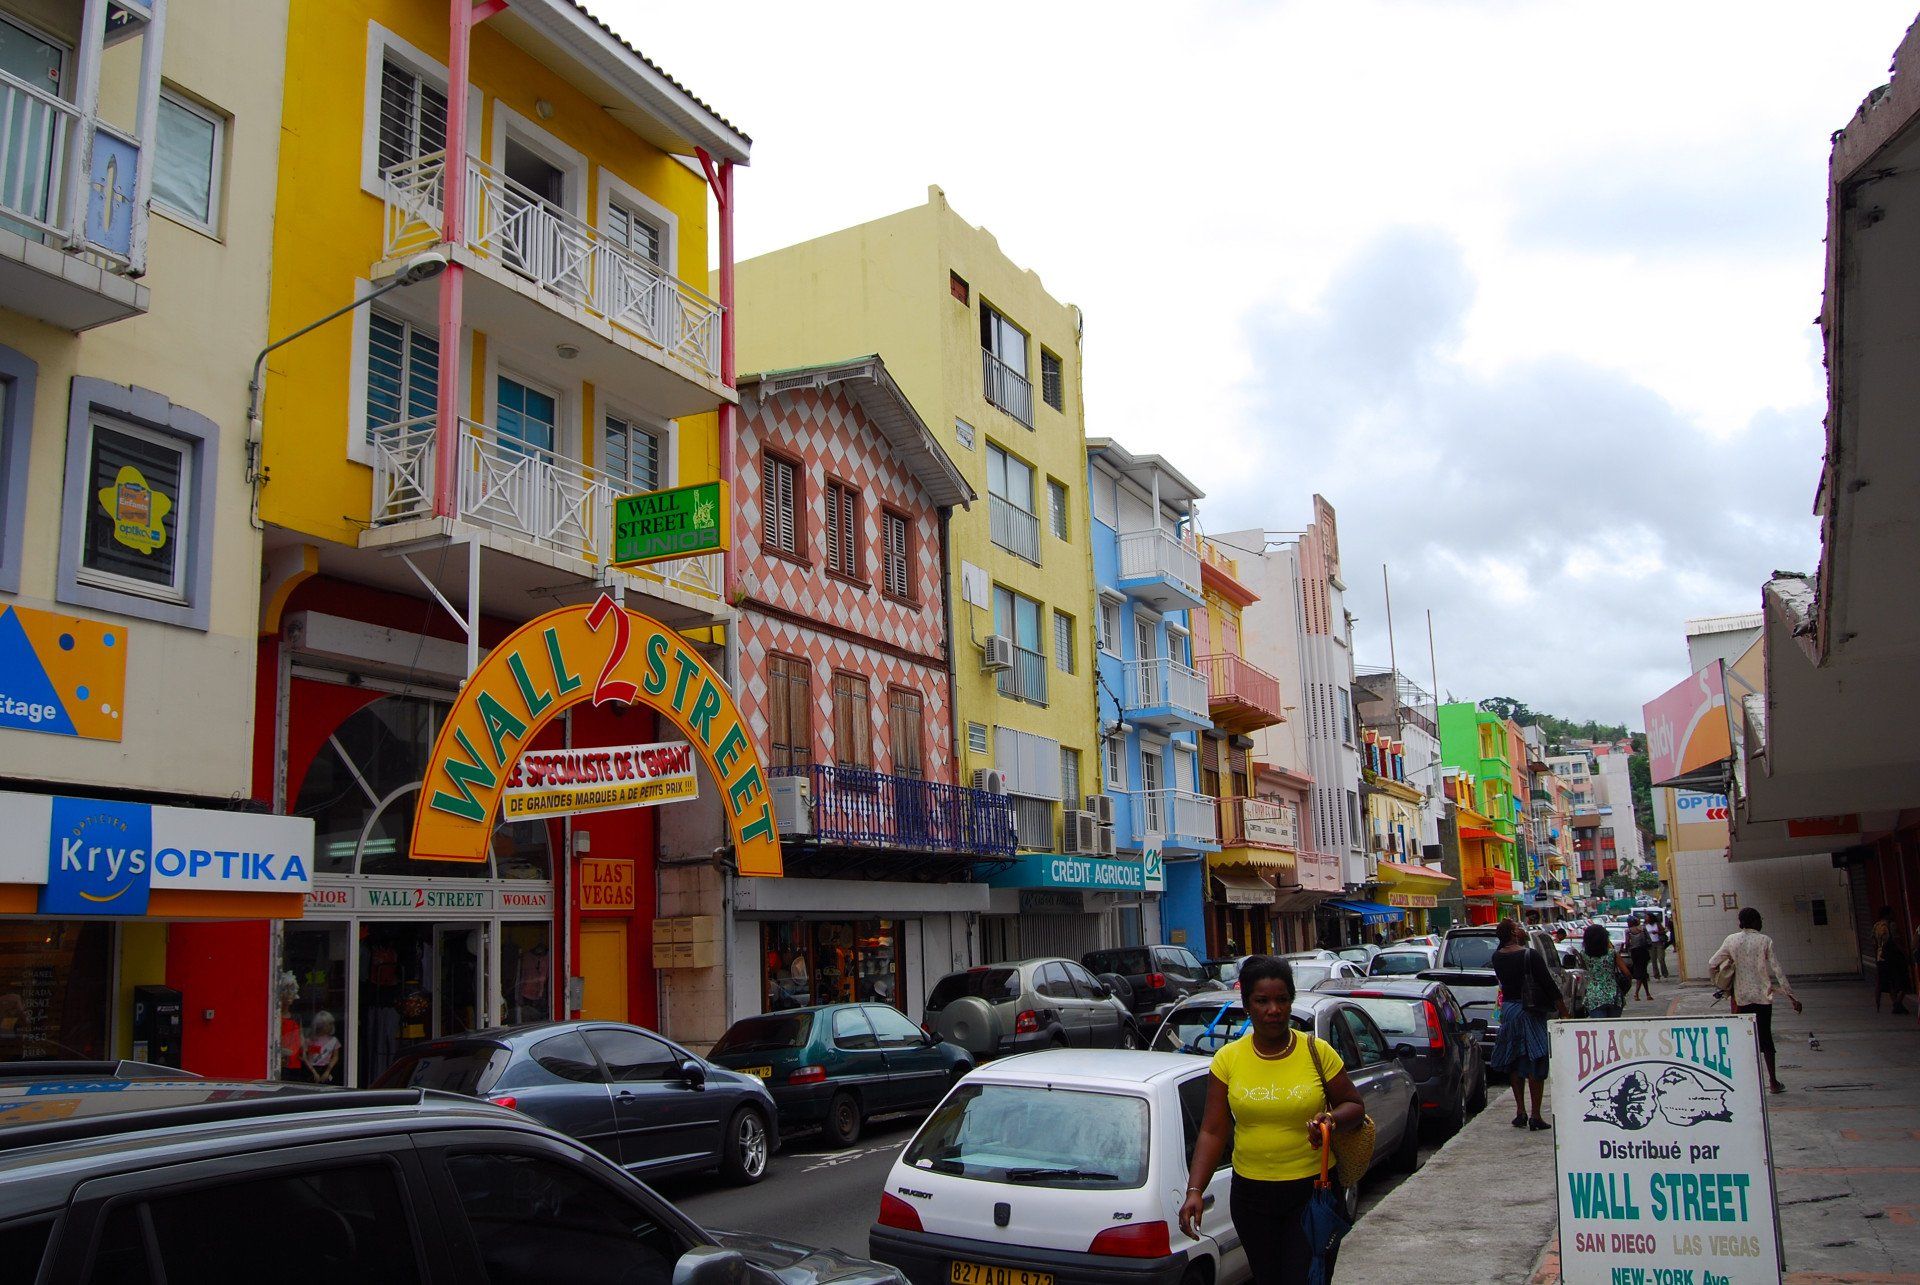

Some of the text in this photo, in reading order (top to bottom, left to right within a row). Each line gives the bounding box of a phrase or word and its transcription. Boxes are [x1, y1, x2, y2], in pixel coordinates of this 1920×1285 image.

[628, 494, 679, 517] WALL
[617, 512, 688, 539] STREET
[617, 527, 718, 558] JUNIOR
[431, 592, 775, 844] WALL 2 STREET
[525, 753, 613, 787] SPECIALISTE
[614, 751, 634, 780] DE
[635, 745, 691, 779] L'ENFANT
[510, 798, 523, 812] DE
[527, 794, 572, 810] GRANDES
[575, 789, 616, 806] MARQUES
[619, 791, 625, 802] A
[628, 789, 638, 801] DE
[640, 785, 663, 799] PETITS
[666, 782, 683, 795] PRIX
[61, 837, 146, 882] Krys
[154, 848, 308, 882] OPTIKA
[1051, 857, 1141, 886] CRÉDIT AGRICOLE
[593, 863, 623, 883] LAS
[303, 890, 347, 904] NIOR
[368, 888, 484, 909] WALL 2 STREET
[503, 894, 547, 906] WOMAN
[583, 885, 633, 905] VEGAS
[1575, 1026, 1733, 1082] BLACK STYLE
[1599, 1140, 1720, 1164] Distribué par
[1568, 1172, 1750, 1222] WALL STREET
[1576, 1232, 1657, 1255] SAN DIEGO
[1673, 1234, 1760, 1258] LAS VEGAS
[954, 1262, 980, 1284] 827
[1611, 1267, 1730, 1285] NEW-YORK Ave
